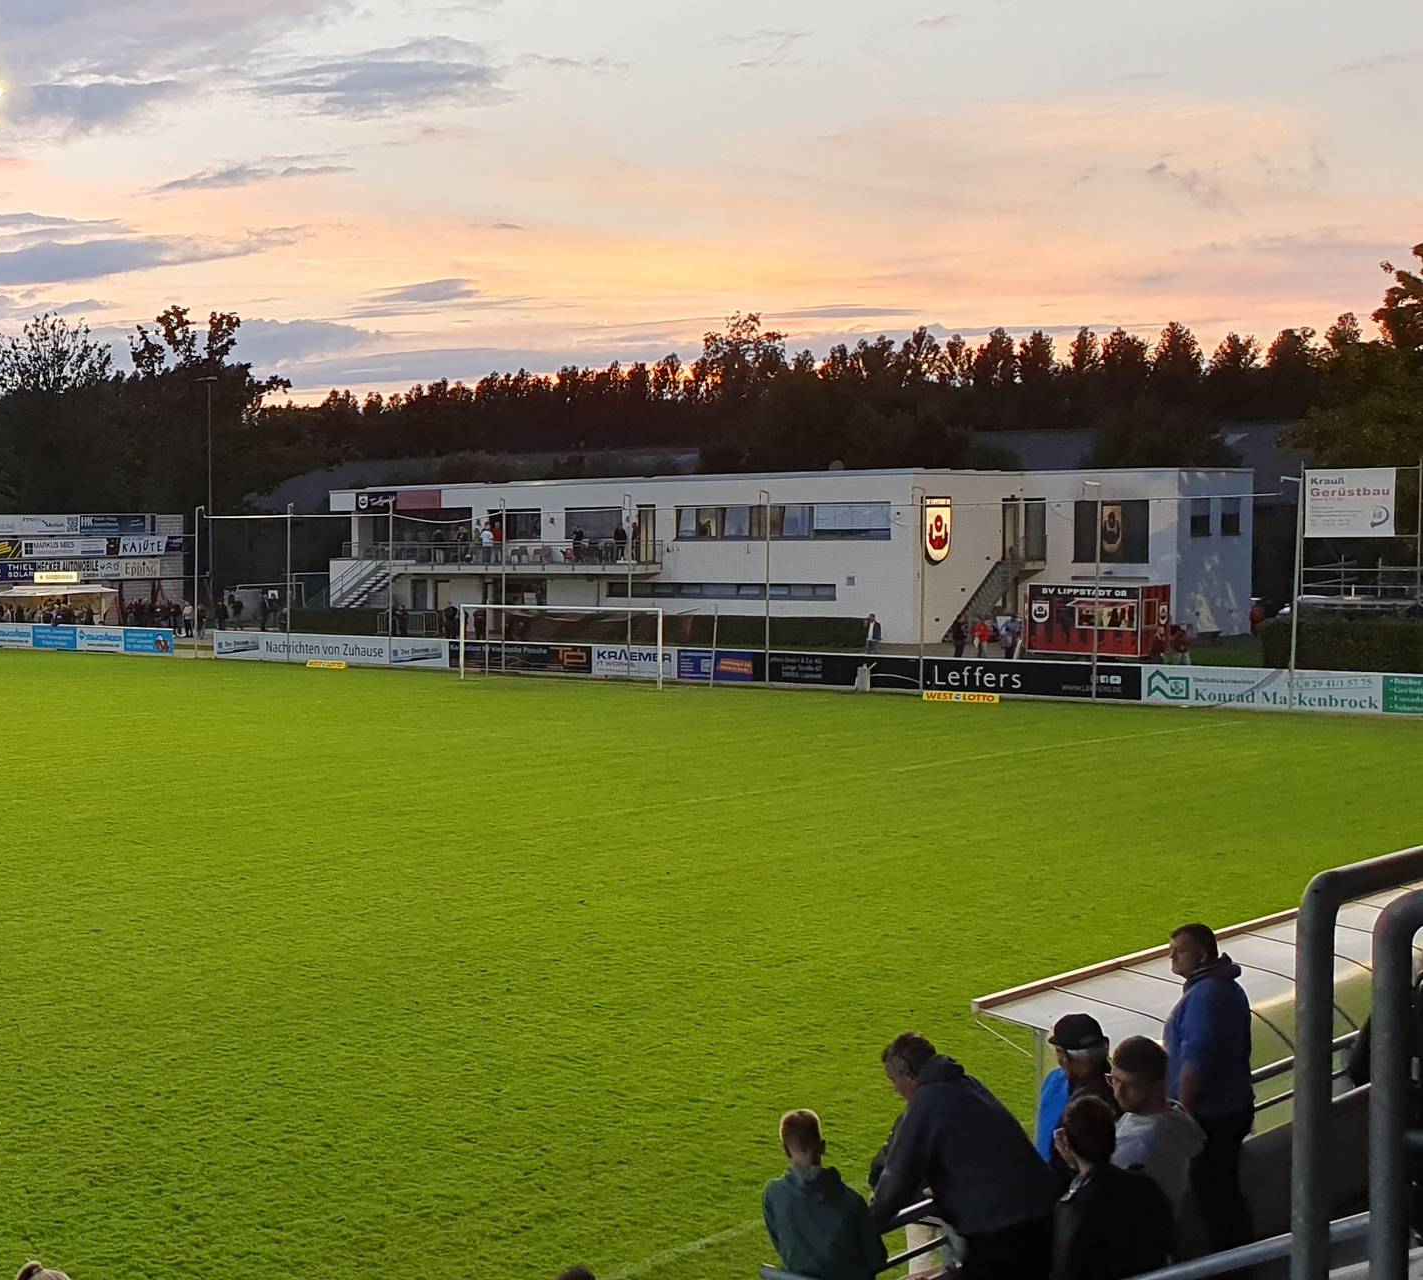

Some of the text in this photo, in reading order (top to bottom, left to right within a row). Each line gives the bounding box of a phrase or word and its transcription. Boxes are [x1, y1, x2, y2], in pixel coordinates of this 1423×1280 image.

[1310, 486, 1390, 497] Gerüstbau
[122, 540, 163, 553] KAJÜTE
[7, 563, 35, 571] THIEL
[1041, 587, 1055, 595] SV
[265, 641, 384, 658] Nachrichten von Zuhause
[934, 664, 1022, 689] Leffers
[926, 692, 995, 702] WEST LOTTO
[1194, 687, 1256, 705] Konrad
[1262, 690, 1379, 710] Mackenbrock
